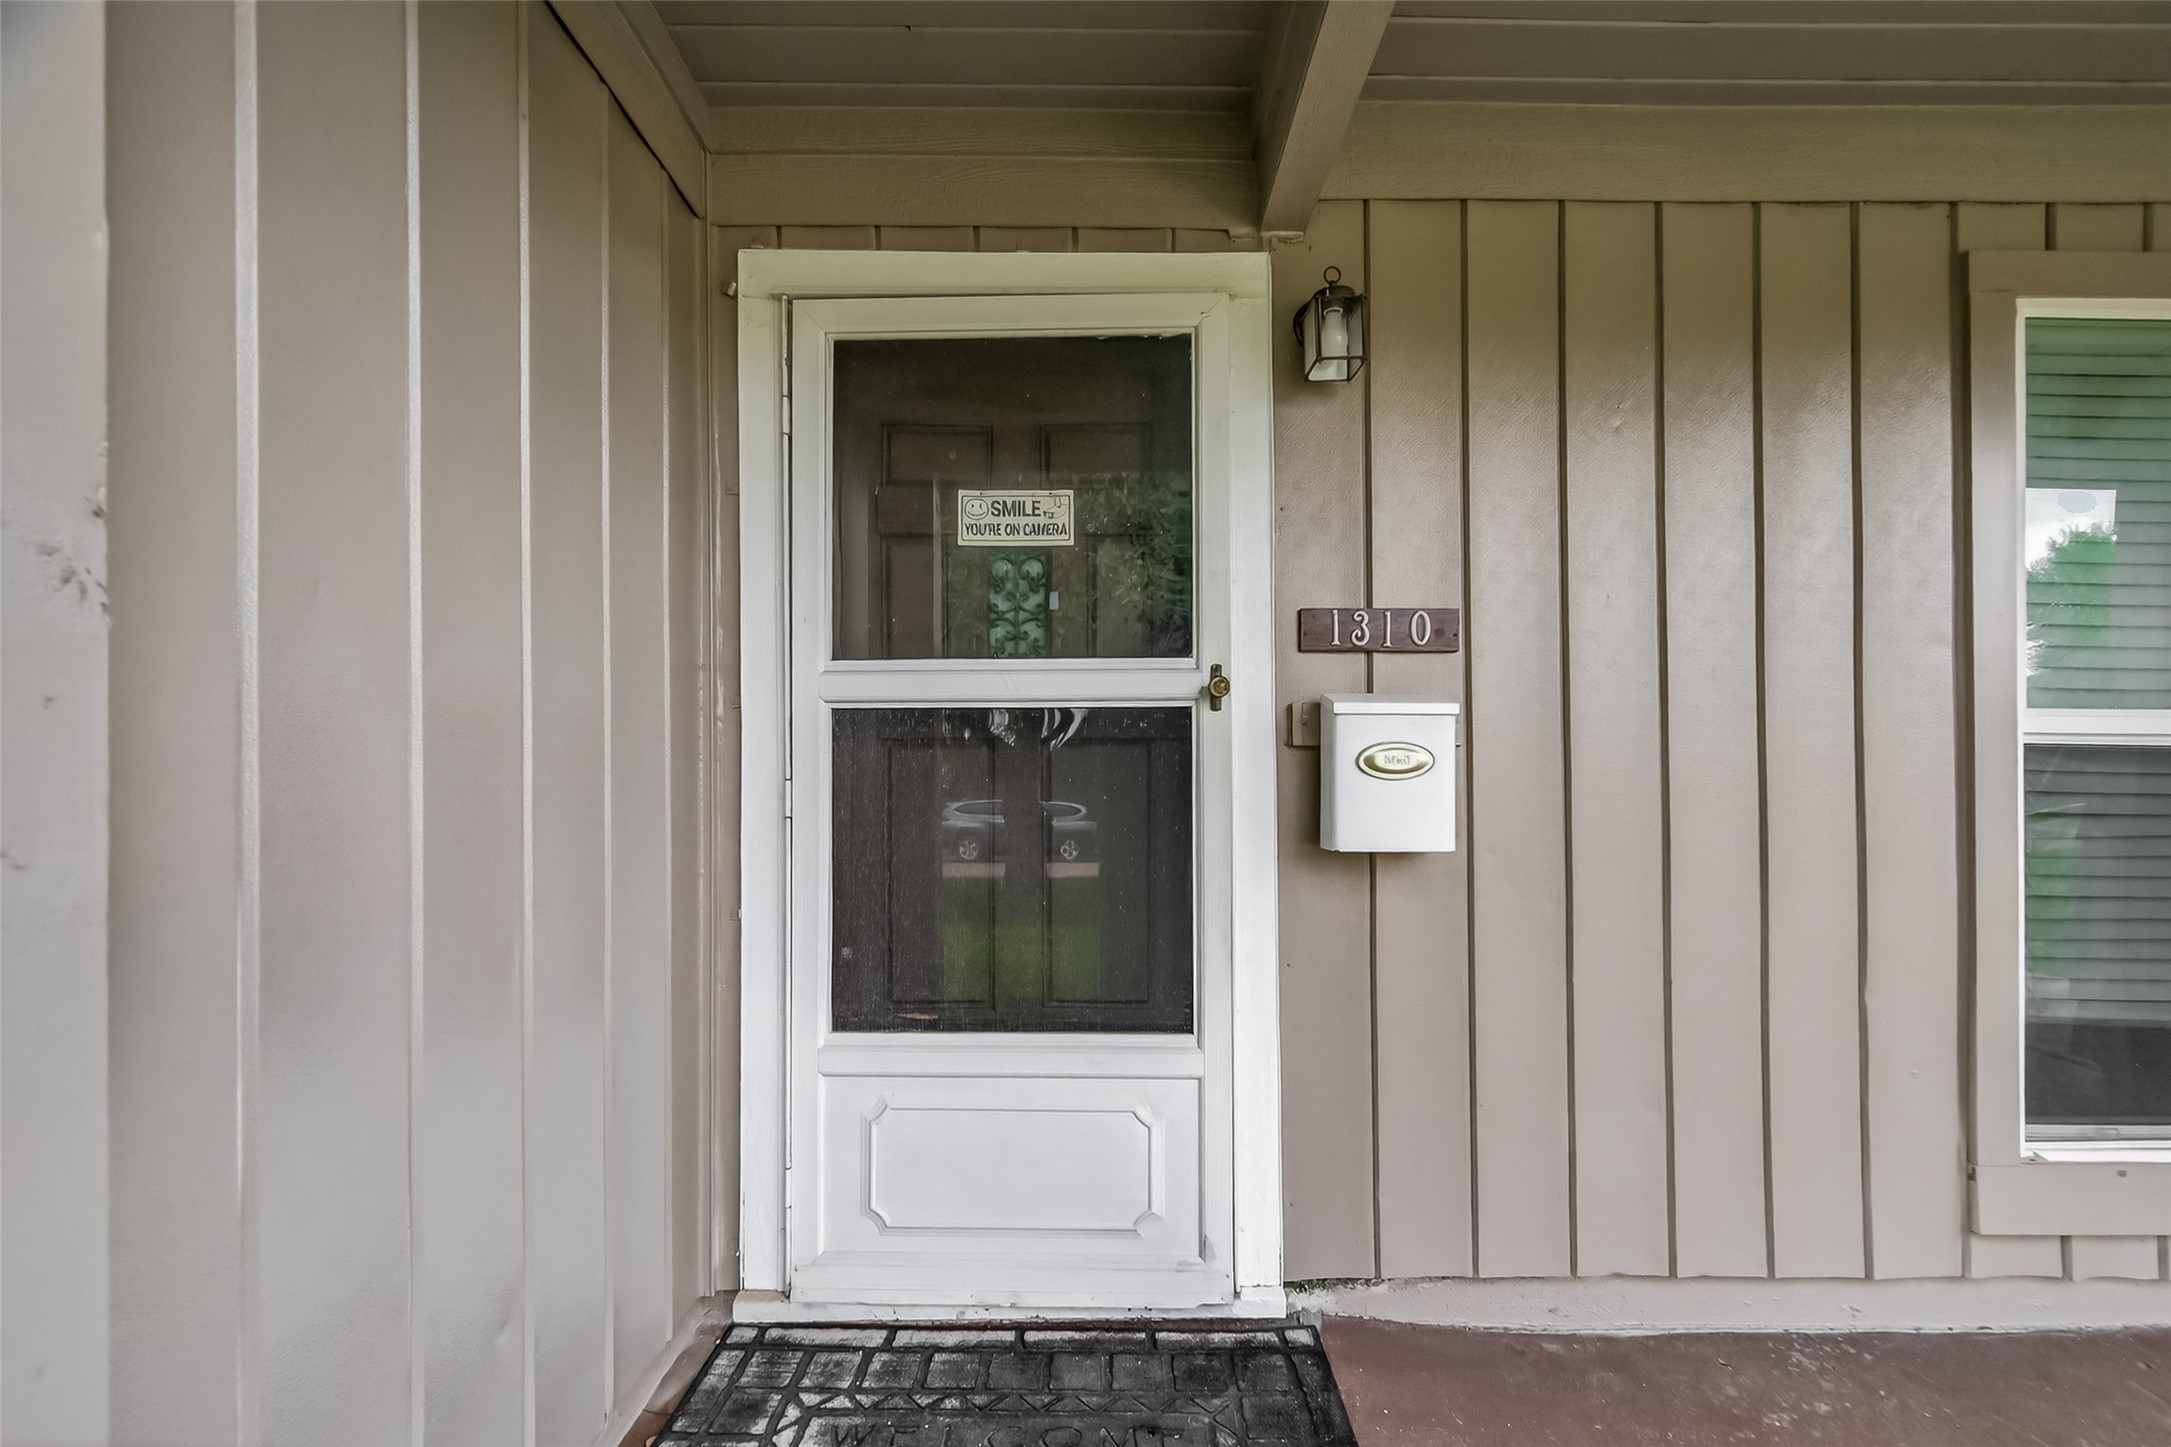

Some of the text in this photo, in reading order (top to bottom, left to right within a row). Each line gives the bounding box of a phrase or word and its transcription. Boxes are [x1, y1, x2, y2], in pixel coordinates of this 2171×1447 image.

[990, 500, 1041, 517] SMILE
[964, 523, 1067, 536] YOU'RE ON CAMERA
[1331, 609, 1432, 648] 1310
